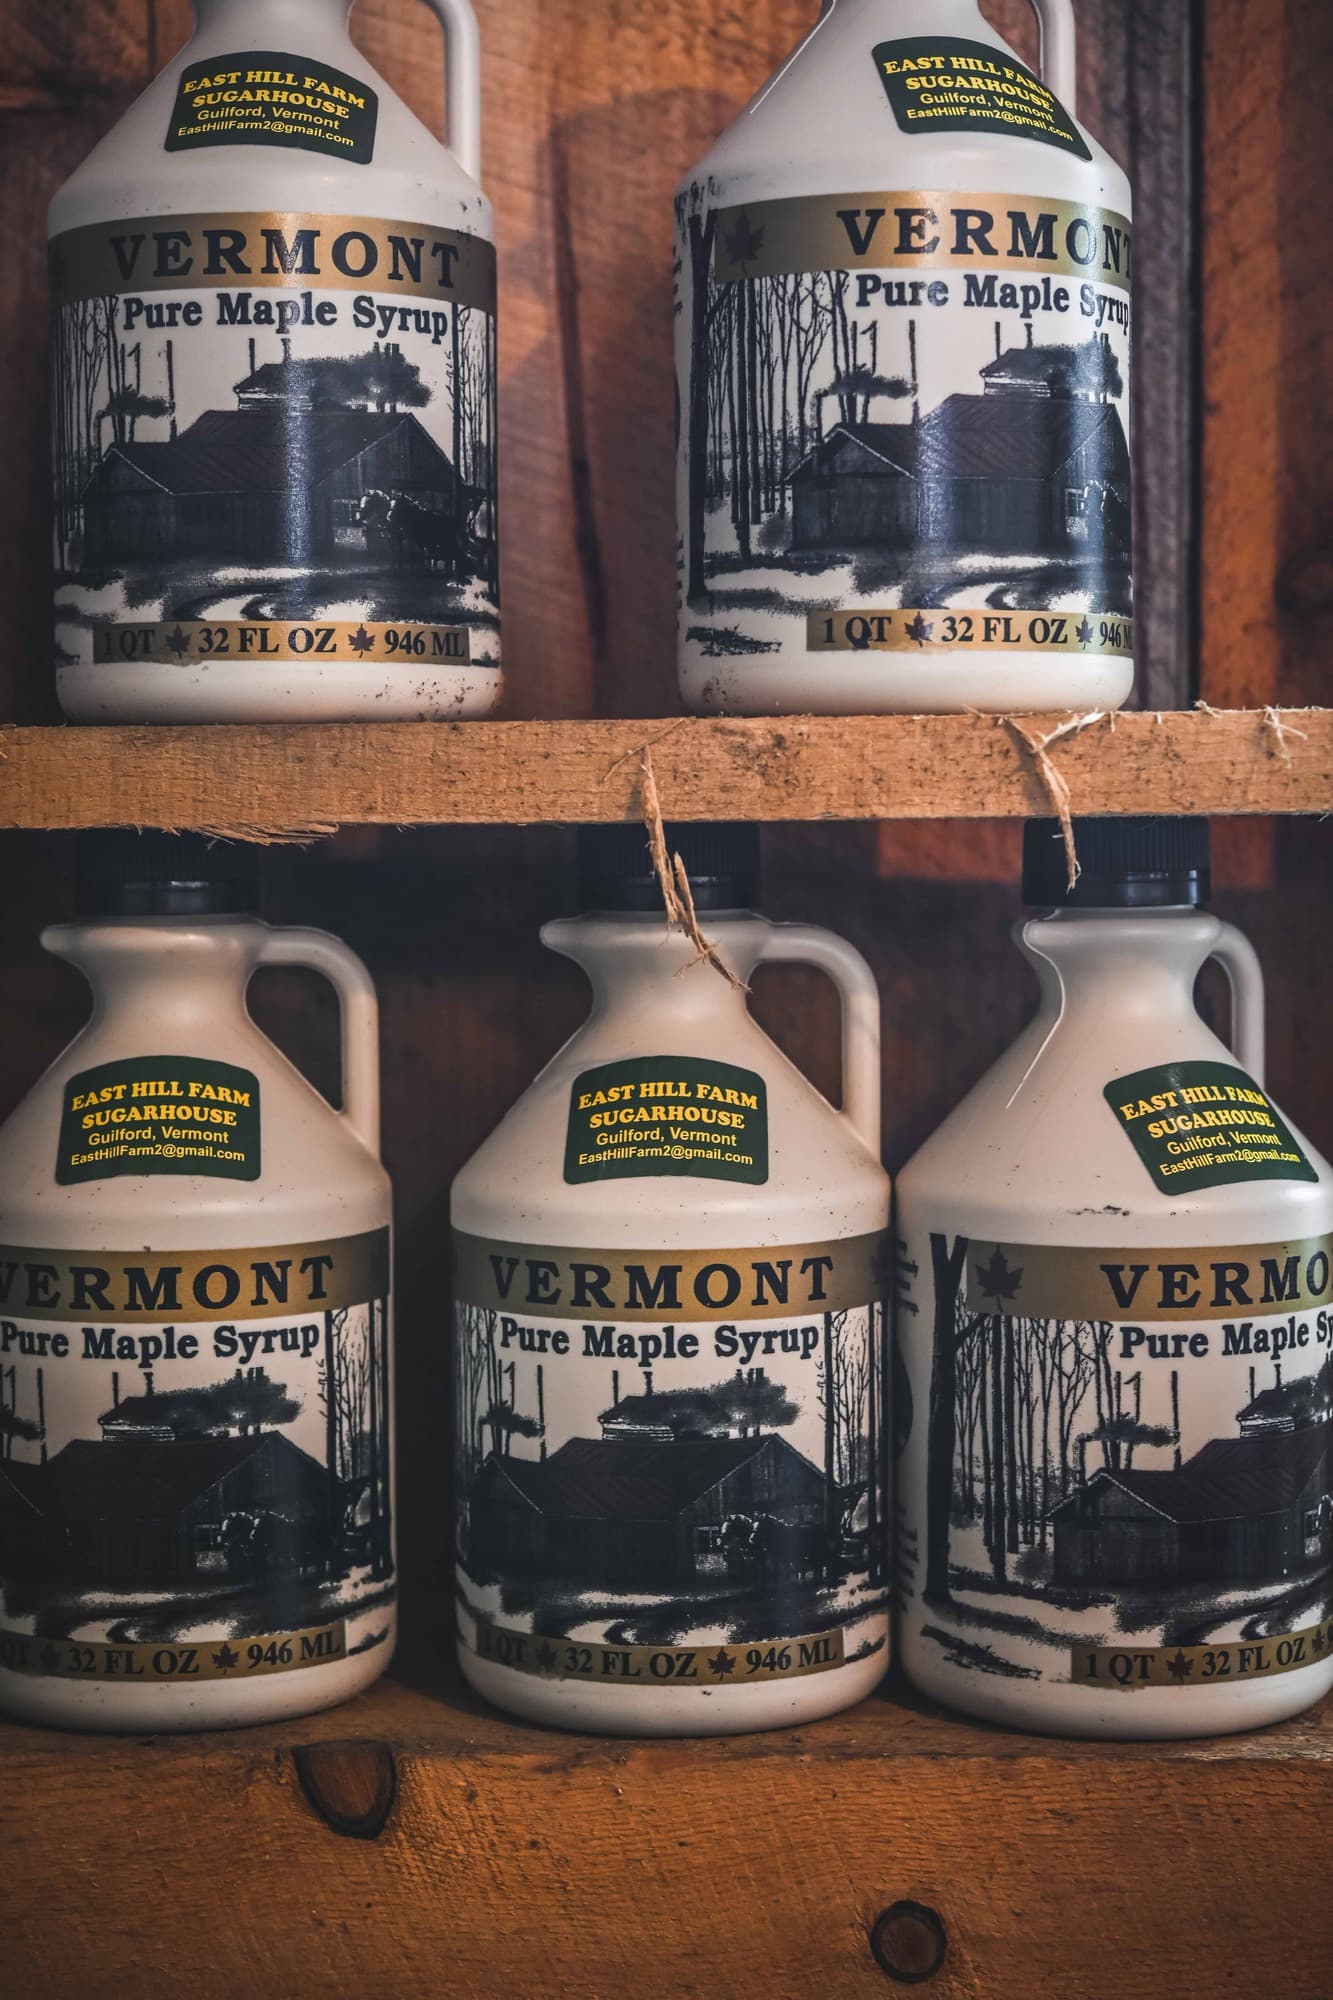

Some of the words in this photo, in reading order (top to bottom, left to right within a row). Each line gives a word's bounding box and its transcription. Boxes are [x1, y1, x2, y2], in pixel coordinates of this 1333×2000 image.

[184, 72, 241, 93] EAST
[245, 71, 298, 86] HILL
[303, 76, 366, 109] FARM
[883, 56, 945, 74] EAST
[950, 57, 1001, 75] HILL
[1003, 66, 1055, 103] FARM
[905, 75, 1054, 113] SUGARHOUSE
[192, 89, 350, 119] SUGARHOUSE
[197, 106, 266, 121] Guilford,
[272, 107, 340, 130] Vermont
[920, 93, 992, 107] Guilford,
[993, 95, 1055, 124] Vermont
[178, 120, 354, 147] EastHillFarm2@gmail.com
[906, 106, 1074, 141] EastHillFarm2@gmail.com
[110, 228, 459, 289] VERMONT
[122, 297, 202, 330] Pure
[216, 292, 338, 335] Maple
[352, 295, 449, 344] Syrup
[855, 275, 949, 307] Pure
[963, 274, 1069, 318] Maple
[1080, 283, 1129, 336] Syrup
[104, 632, 113, 656] 1
[120, 628, 155, 657] QT
[198, 628, 229, 653] 32
[237, 628, 279, 653] FL
[288, 628, 337, 654] OZ
[384, 629, 426, 656] 946
[431, 632, 465, 657] ML
[824, 617, 835, 643] 1
[845, 616, 891, 649] QT
[942, 616, 974, 642] 32
[982, 617, 1022, 643] FL
[1028, 617, 1068, 644] OZ
[1100, 621, 1121, 648] 946
[71, 1084, 127, 1111] EAST
[131, 1081, 184, 1097] HILL
[188, 1082, 250, 1107] FARM
[578, 1084, 635, 1110] EAST
[639, 1082, 691, 1098] HILL
[696, 1083, 759, 1110] FARM
[1120, 1092, 1178, 1121] EAST
[1179, 1085, 1227, 1104] HILL
[1224, 1086, 1269, 1108] FARM
[82, 1105, 237, 1129] SUGARHOUSE
[589, 1106, 745, 1129] SUGARHOUSE
[1147, 1110, 1275, 1139] SUGARHOUSE
[88, 1126, 156, 1146] Guilford,
[161, 1126, 229, 1144] Vermont
[596, 1128, 664, 1146] Guilford,
[669, 1126, 737, 1147] Vermont
[1167, 1132, 1232, 1155] Guilford,
[1230, 1131, 1282, 1146] Vermont
[71, 1144, 245, 1166] EastHillFarm2@gmail.com
[579, 1145, 753, 1165] EastHillFarm2@gmail.com
[1160, 1149, 1300, 1176] EastHillFarm2@gmail.com
[488, 1256, 834, 1309] VERMONT
[1100, 1248, 1333, 1309] VERMO
[1, 1320, 69, 1358] Pure
[82, 1327, 199, 1369] Maple
[213, 1323, 320, 1364] Syrup
[501, 1317, 570, 1355] Pure
[582, 1325, 699, 1366] Maple
[714, 1316, 819, 1365] Syrup
[1120, 1326, 1209, 1359] Pure
[1222, 1316, 1309, 1361] Maple
[68, 1648, 97, 1672] 32
[104, 1651, 144, 1674] FL
[153, 1650, 200, 1675] OZ
[247, 1639, 293, 1668] 946
[299, 1630, 341, 1660] ML
[497, 1634, 526, 1665] QT
[565, 1647, 593, 1672] 32
[601, 1651, 641, 1676] FL
[649, 1652, 697, 1678] OZ
[745, 1645, 791, 1674] 946
[798, 1638, 837, 1667] ML
[1087, 1653, 1098, 1678] 1
[1108, 1654, 1155, 1685] QT
[1201, 1651, 1231, 1678] 32
[1238, 1646, 1271, 1673] FL
[1275, 1637, 1305, 1665] OZ
